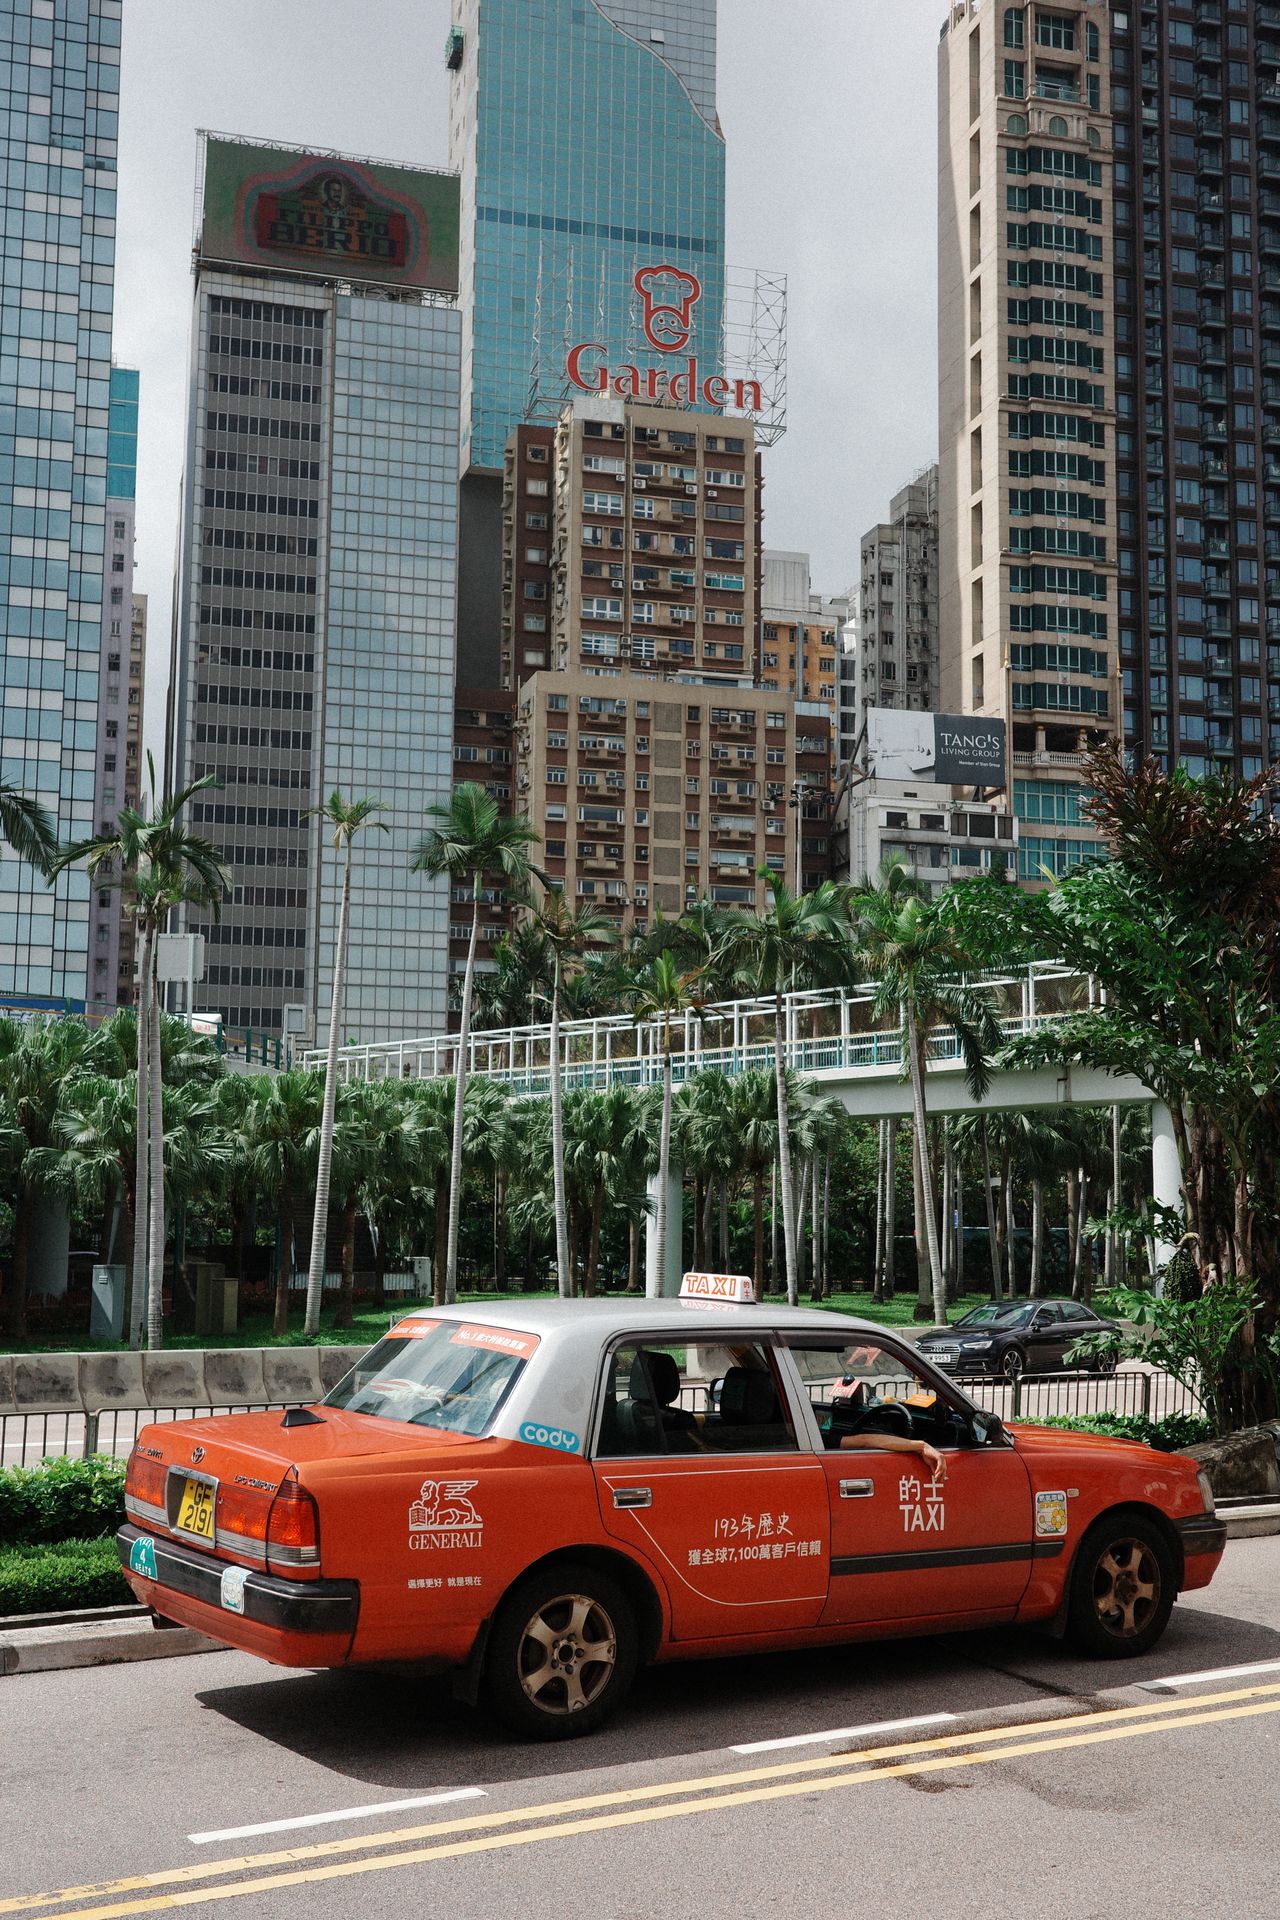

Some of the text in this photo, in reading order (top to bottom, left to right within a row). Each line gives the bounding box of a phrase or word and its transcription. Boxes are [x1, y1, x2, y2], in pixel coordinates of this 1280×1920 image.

[278, 208, 389, 236] FILIPPO
[269, 222, 397, 257] BERIO
[566, 343, 763, 412] Garden
[941, 733, 1000, 750] TANG'S
[941, 747, 1000, 758] LIVING GROUP
[686, 1275, 737, 1297] TAXI
[743, 1280, 751, 1298] 的士
[524, 1424, 576, 1449] cody
[193, 1482, 214, 1507] GF
[247, 1477, 278, 1493] COMFORT
[899, 1474, 944, 1502] 的士
[183, 1504, 213, 1535] 2191
[899, 1503, 945, 1532] TAXI
[408, 1531, 484, 1550] GENERALI
[139, 1548, 146, 1564] 4
[135, 1562, 152, 1576] SEATS
